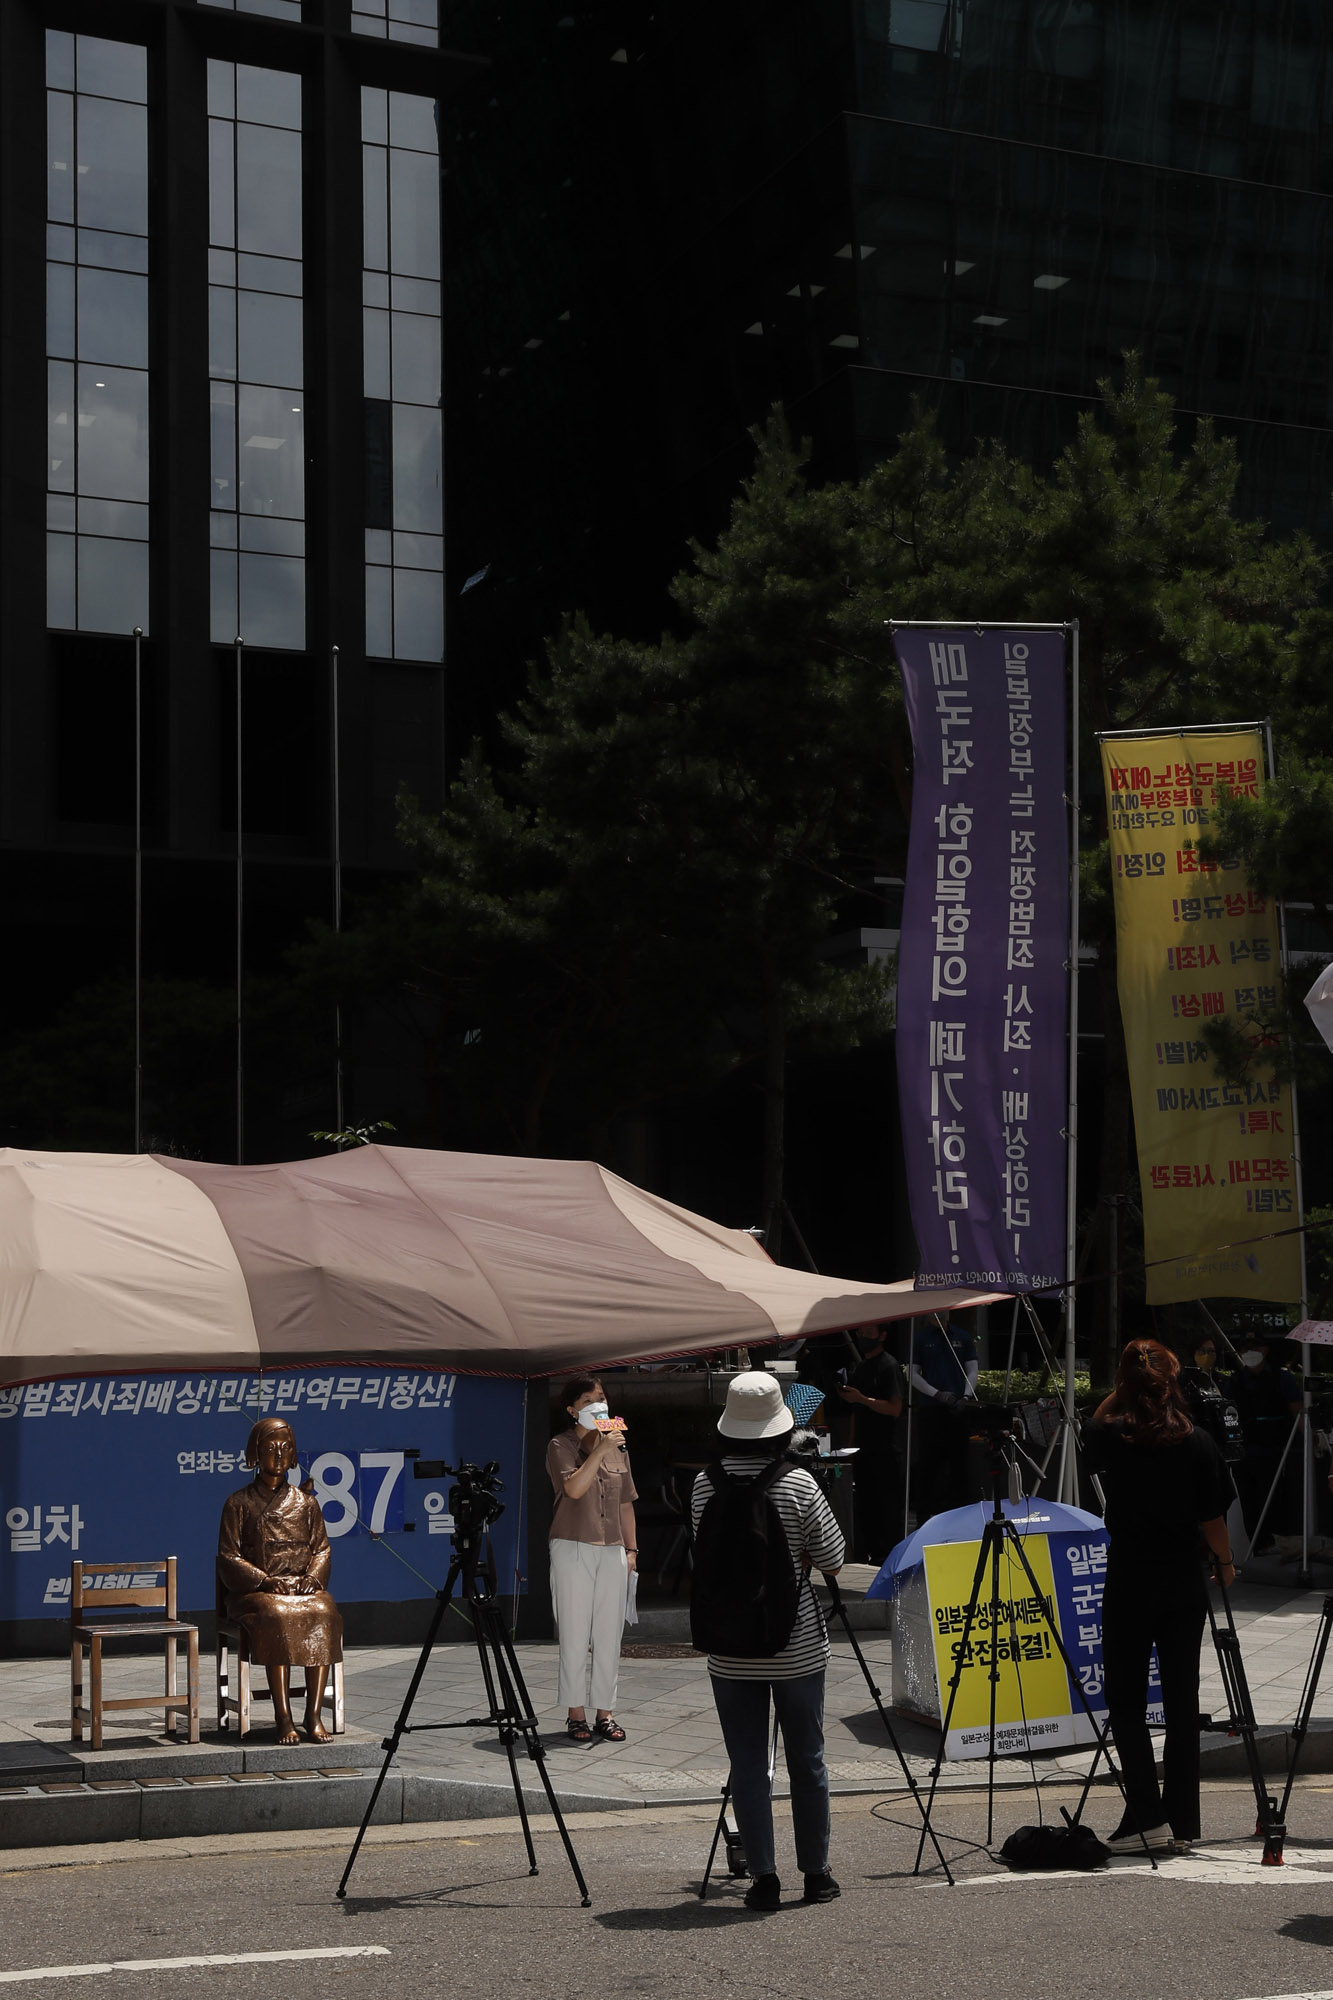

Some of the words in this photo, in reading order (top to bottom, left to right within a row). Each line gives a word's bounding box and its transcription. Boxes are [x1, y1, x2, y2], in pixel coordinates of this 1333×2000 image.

[284, 1451, 404, 1538] 87
[5, 1504, 84, 1552] 일차
[961, 1723, 1059, 1745] 일본군성예제문제해결을위한
